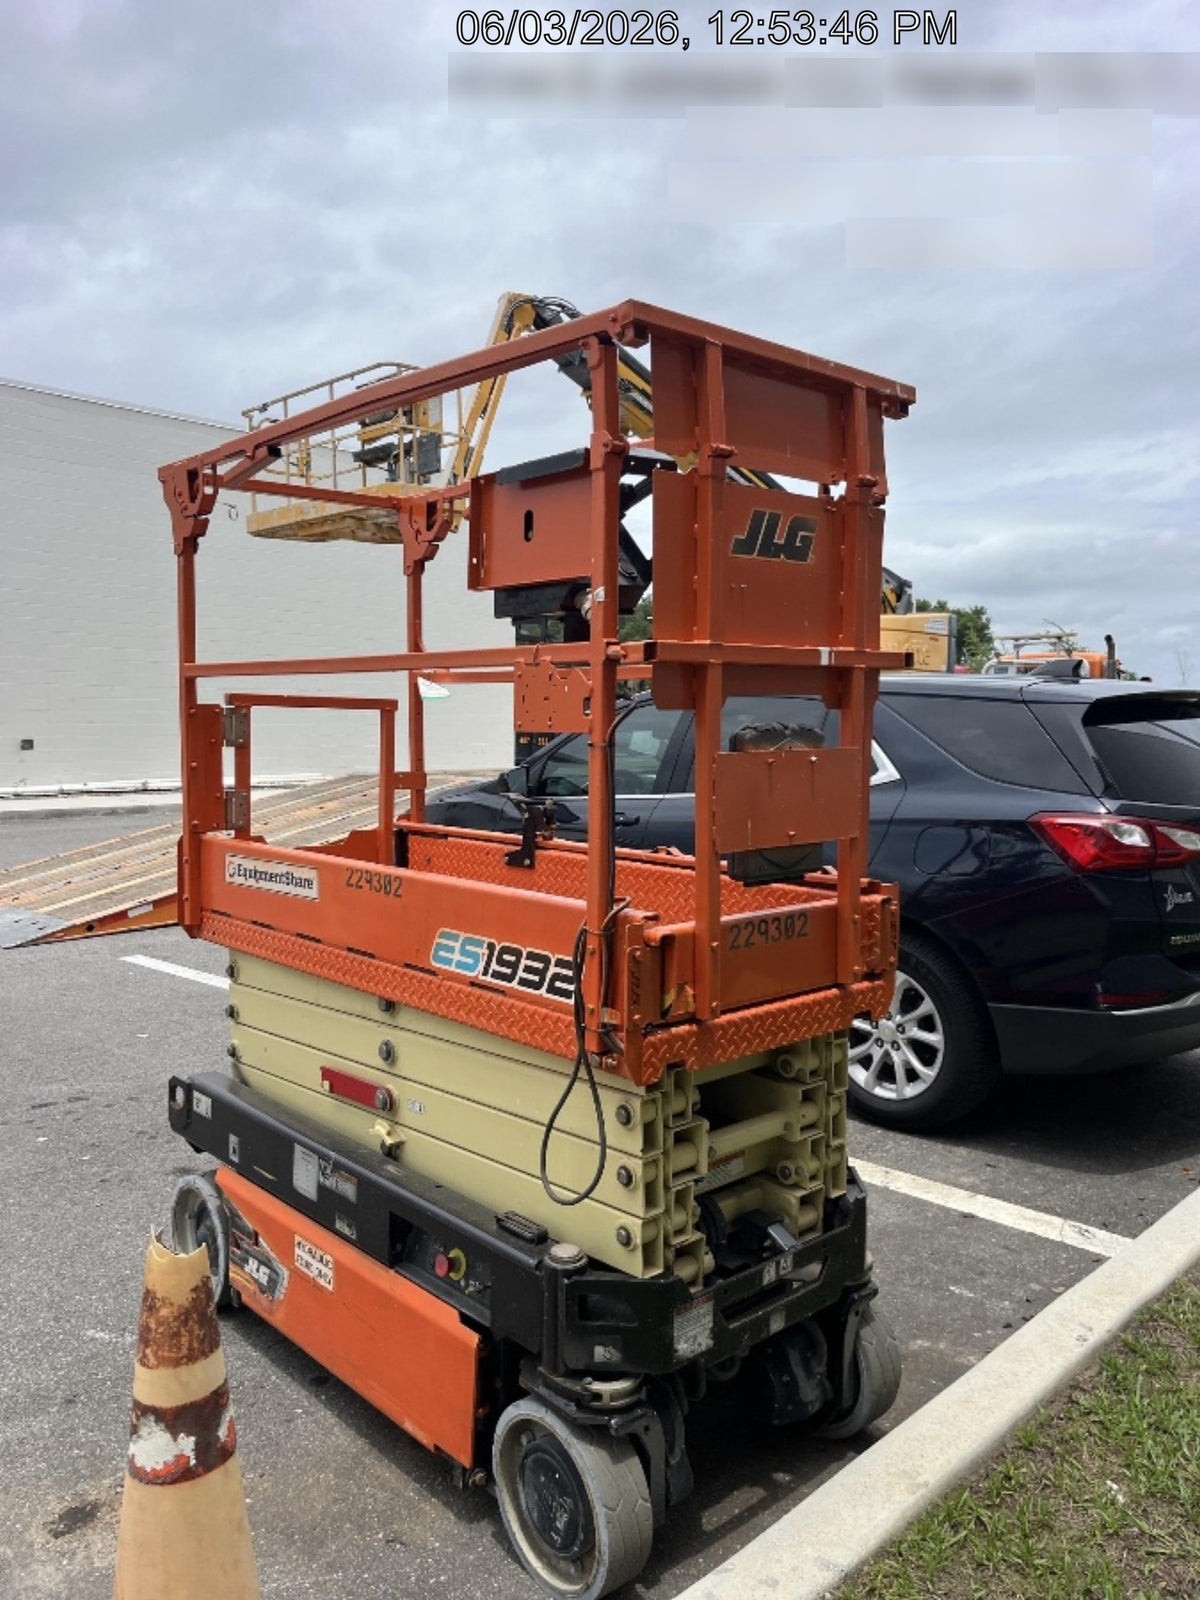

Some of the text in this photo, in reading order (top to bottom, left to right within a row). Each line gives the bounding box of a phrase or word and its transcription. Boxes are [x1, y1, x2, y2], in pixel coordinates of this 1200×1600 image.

[731, 510, 817, 562] JLG
[237, 862, 314, 890] EquipmentShare
[345, 867, 403, 898] 229302
[728, 911, 809, 951] 229302
[431, 928, 575, 1001] ES1932
